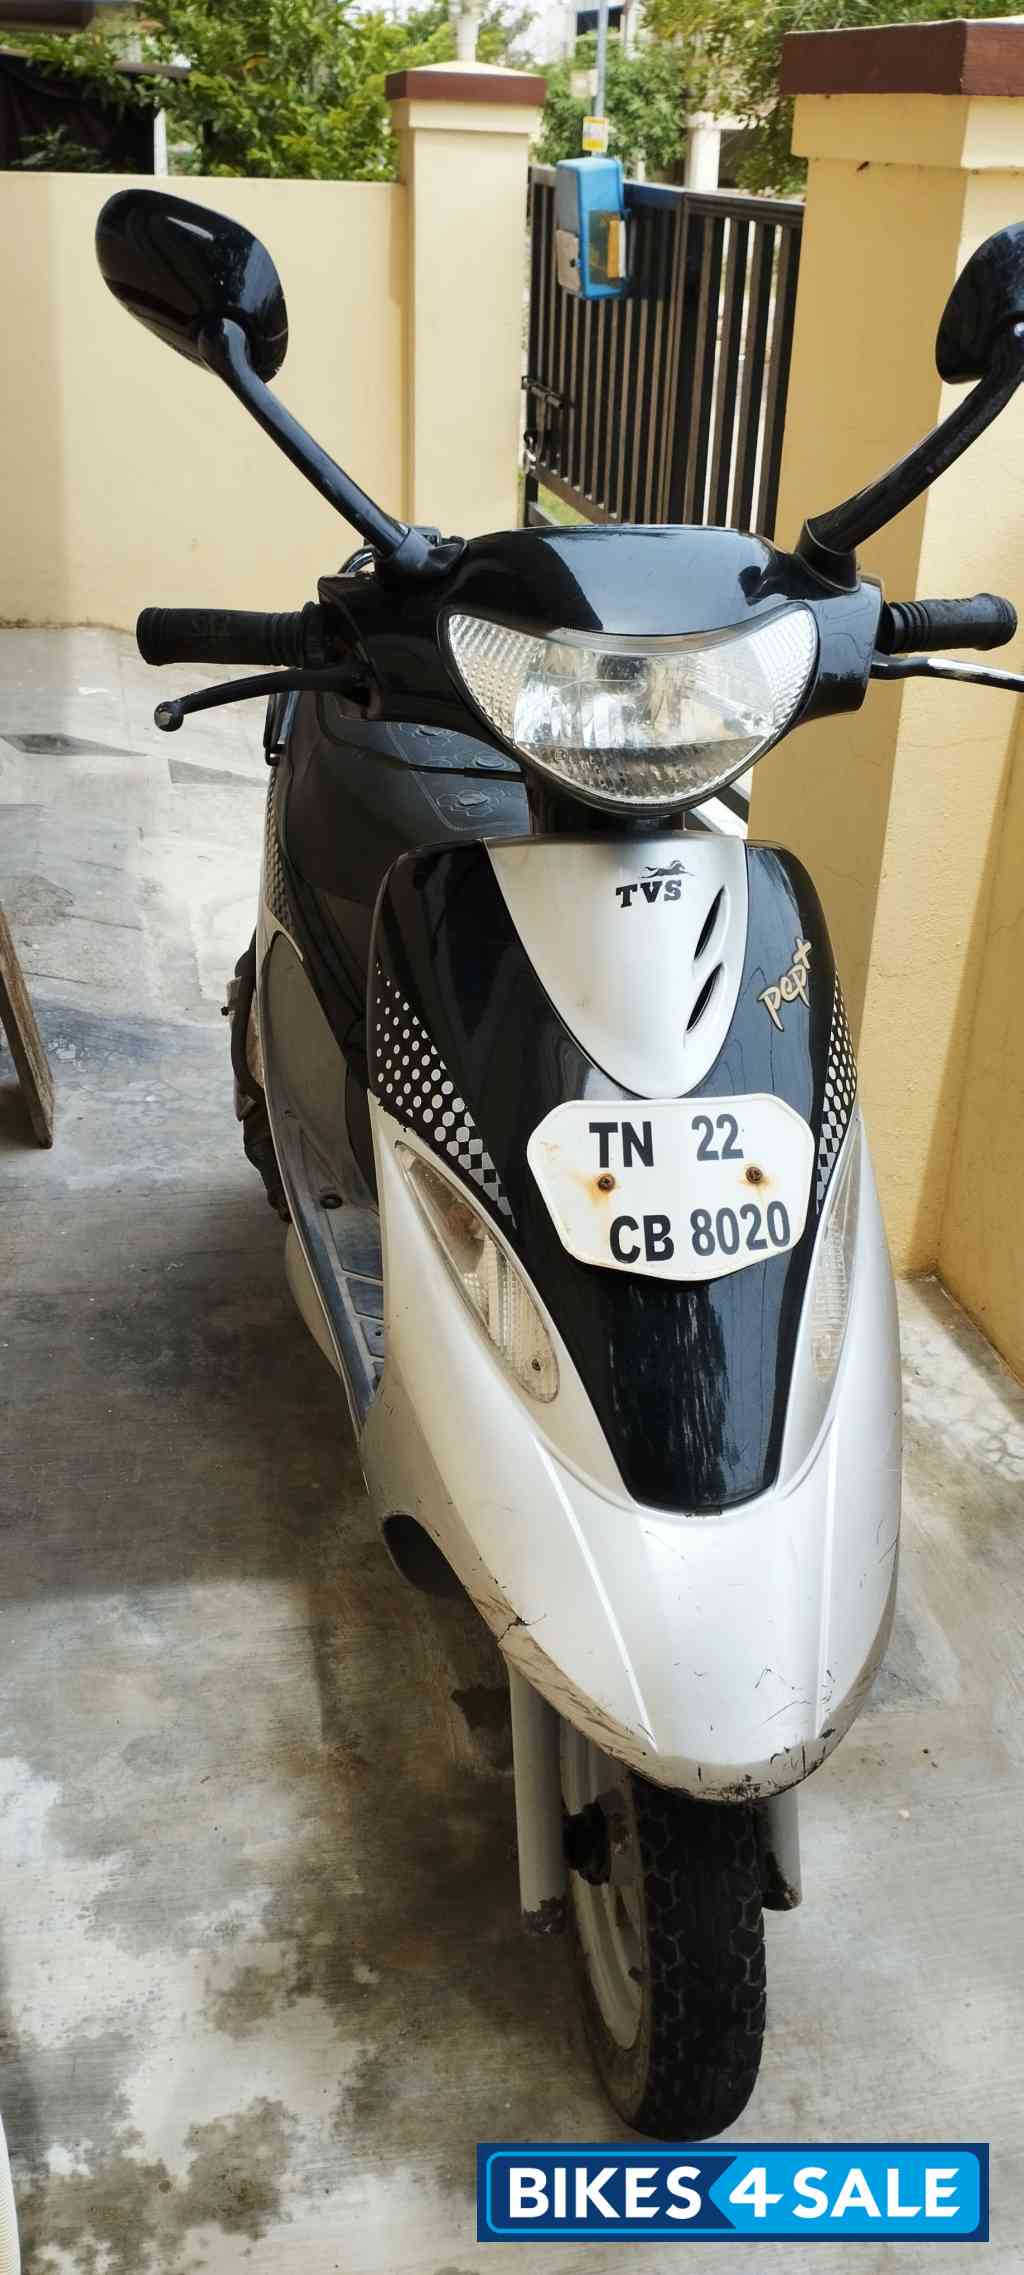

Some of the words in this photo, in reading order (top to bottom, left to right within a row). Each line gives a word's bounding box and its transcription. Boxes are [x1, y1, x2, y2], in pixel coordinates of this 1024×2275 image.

[615, 880, 682, 908] TVS
[589, 1121, 654, 1168] TN
[691, 1113, 744, 1161] 22
[610, 1214, 674, 1264] CB
[690, 1201, 790, 1256] 8020
